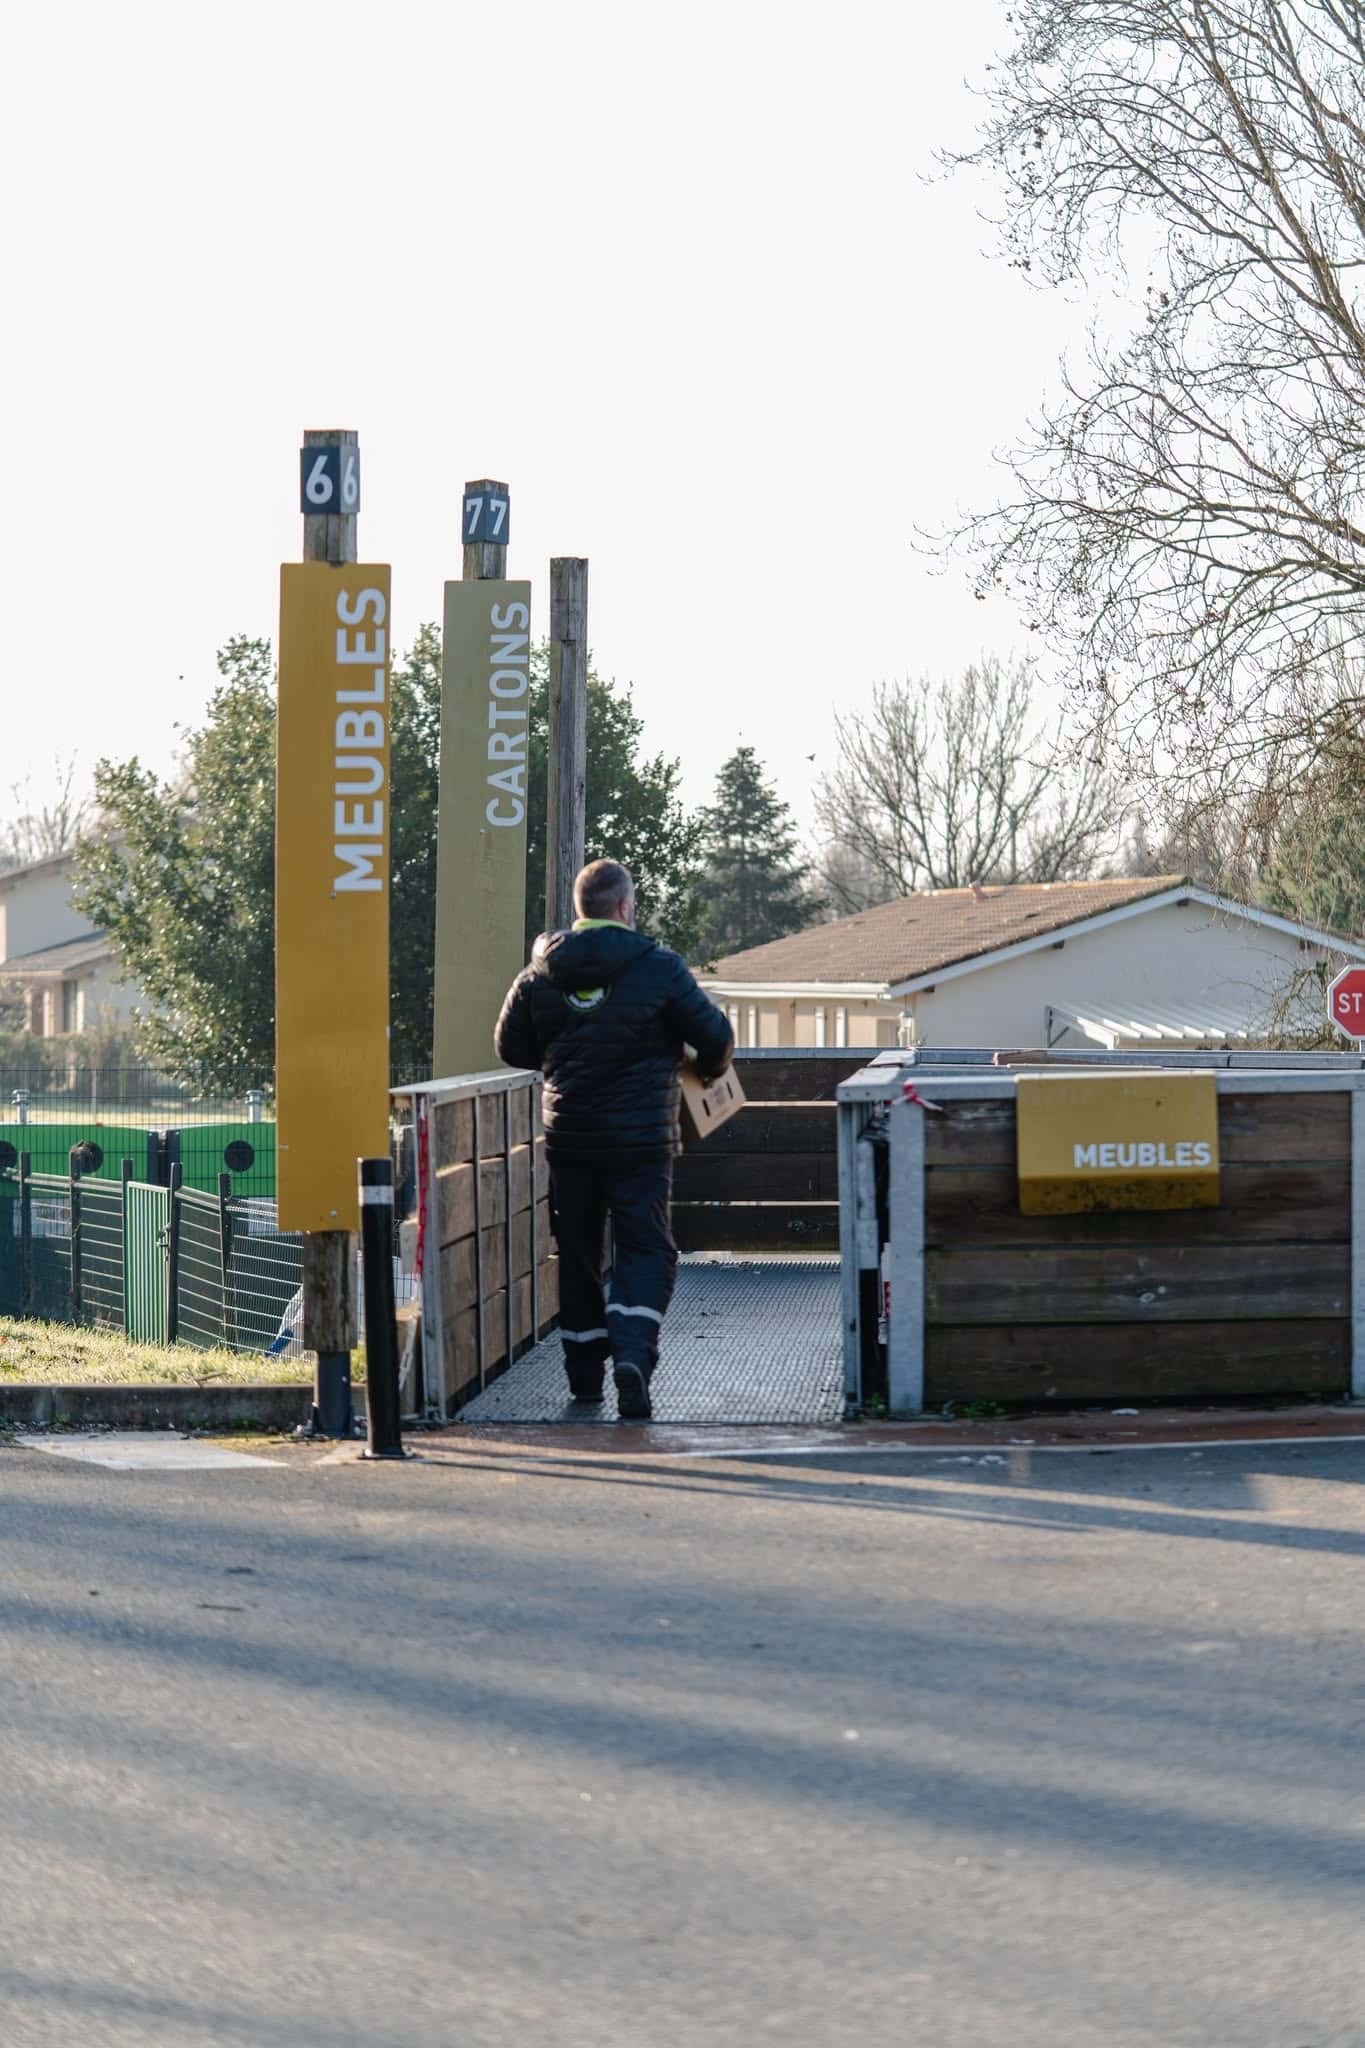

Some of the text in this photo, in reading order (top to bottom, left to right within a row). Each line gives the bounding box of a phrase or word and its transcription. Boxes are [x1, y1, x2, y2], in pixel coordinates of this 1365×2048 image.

[306, 454, 333, 504] 6
[344, 455, 358, 504] 6
[466, 497, 483, 535] 7
[490, 499, 507, 535] 7
[486, 601, 529, 827] CARTONS
[333, 588, 386, 893] MEUBLES
[1073, 1142, 1212, 1168] MEUBLES
